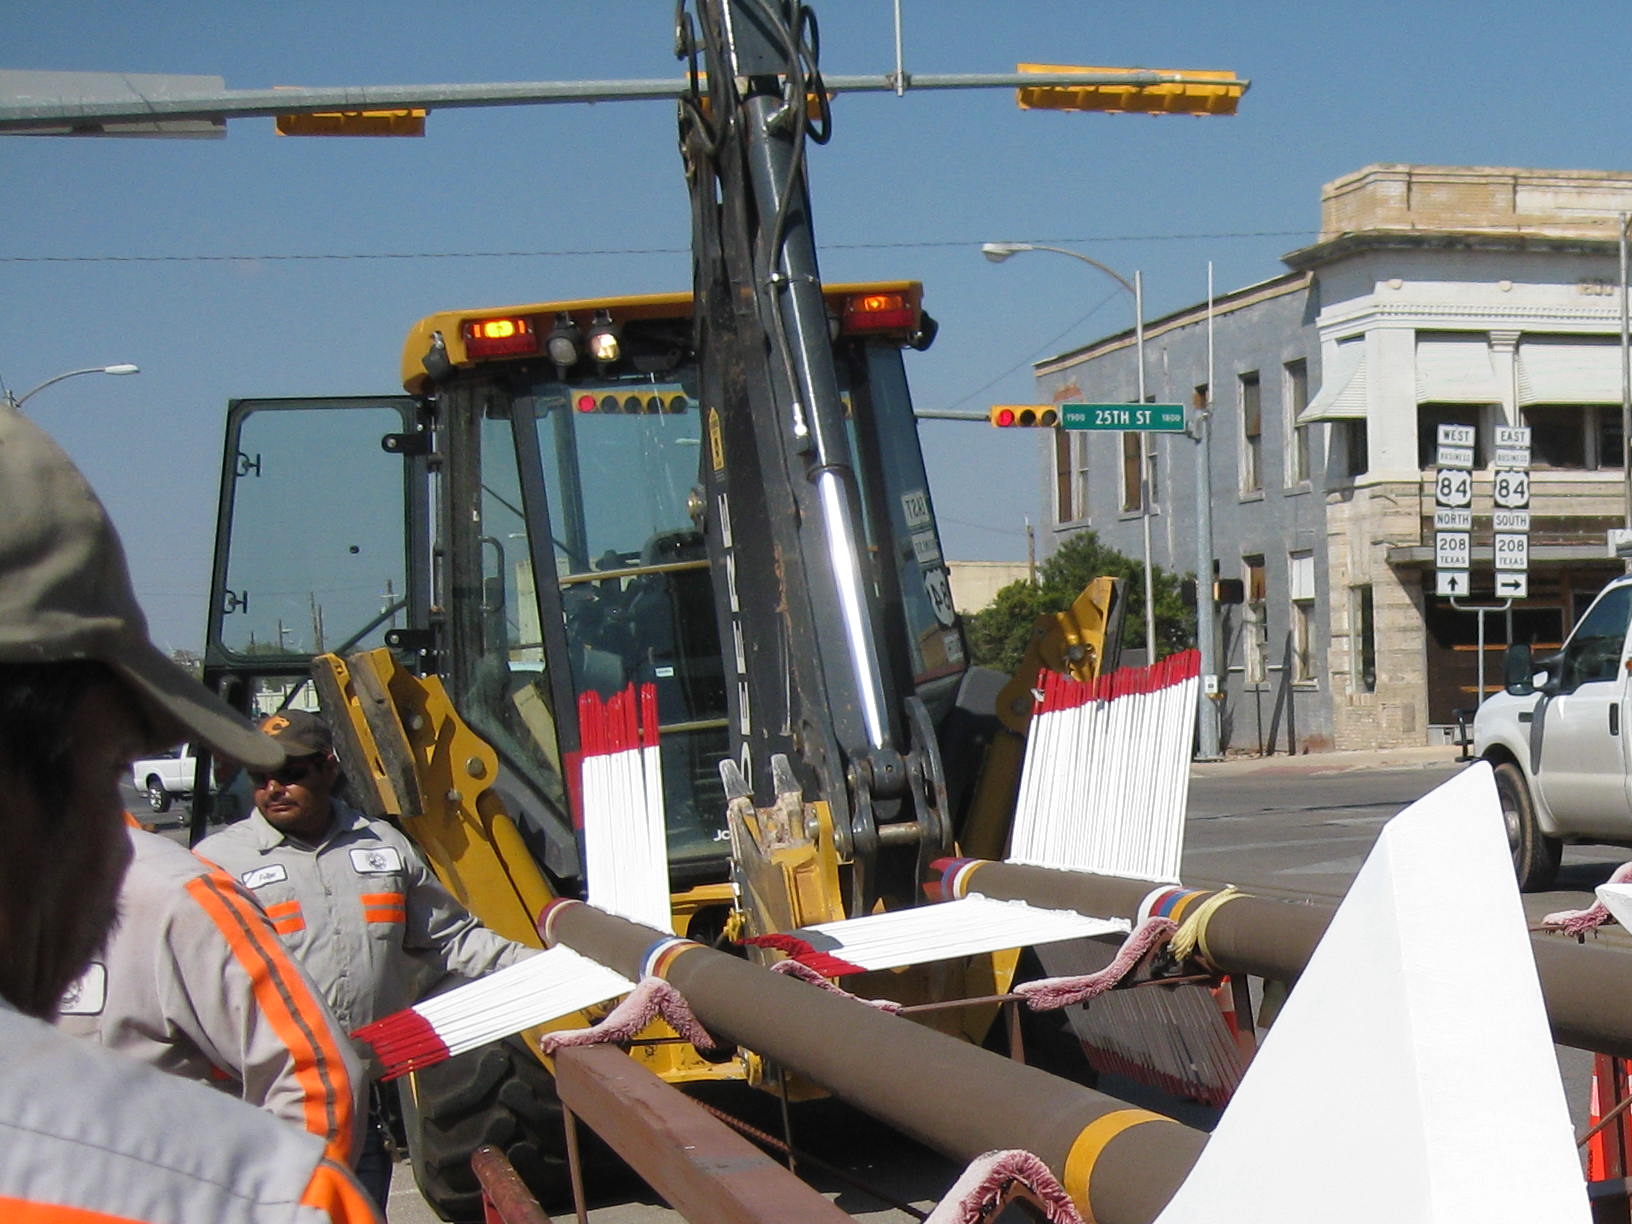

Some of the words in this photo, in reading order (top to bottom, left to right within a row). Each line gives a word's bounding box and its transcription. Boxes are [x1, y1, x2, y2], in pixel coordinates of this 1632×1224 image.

[1095, 410, 1130, 425] 25TH
[1136, 410, 1152, 425] ST
[1443, 430, 1470, 441] WEST
[1500, 431, 1526, 442] EAST
[1439, 477, 1468, 498] 84
[1498, 478, 1526, 499] 84
[1437, 513, 1469, 525] NORTH
[1496, 515, 1527, 526] SOUTH
[1439, 538, 1466, 551] 208
[1498, 539, 1525, 552] 208
[1439, 555, 1466, 564] TEXAS
[1499, 557, 1525, 566] TEXAS
[717, 493, 754, 796] DEERE
